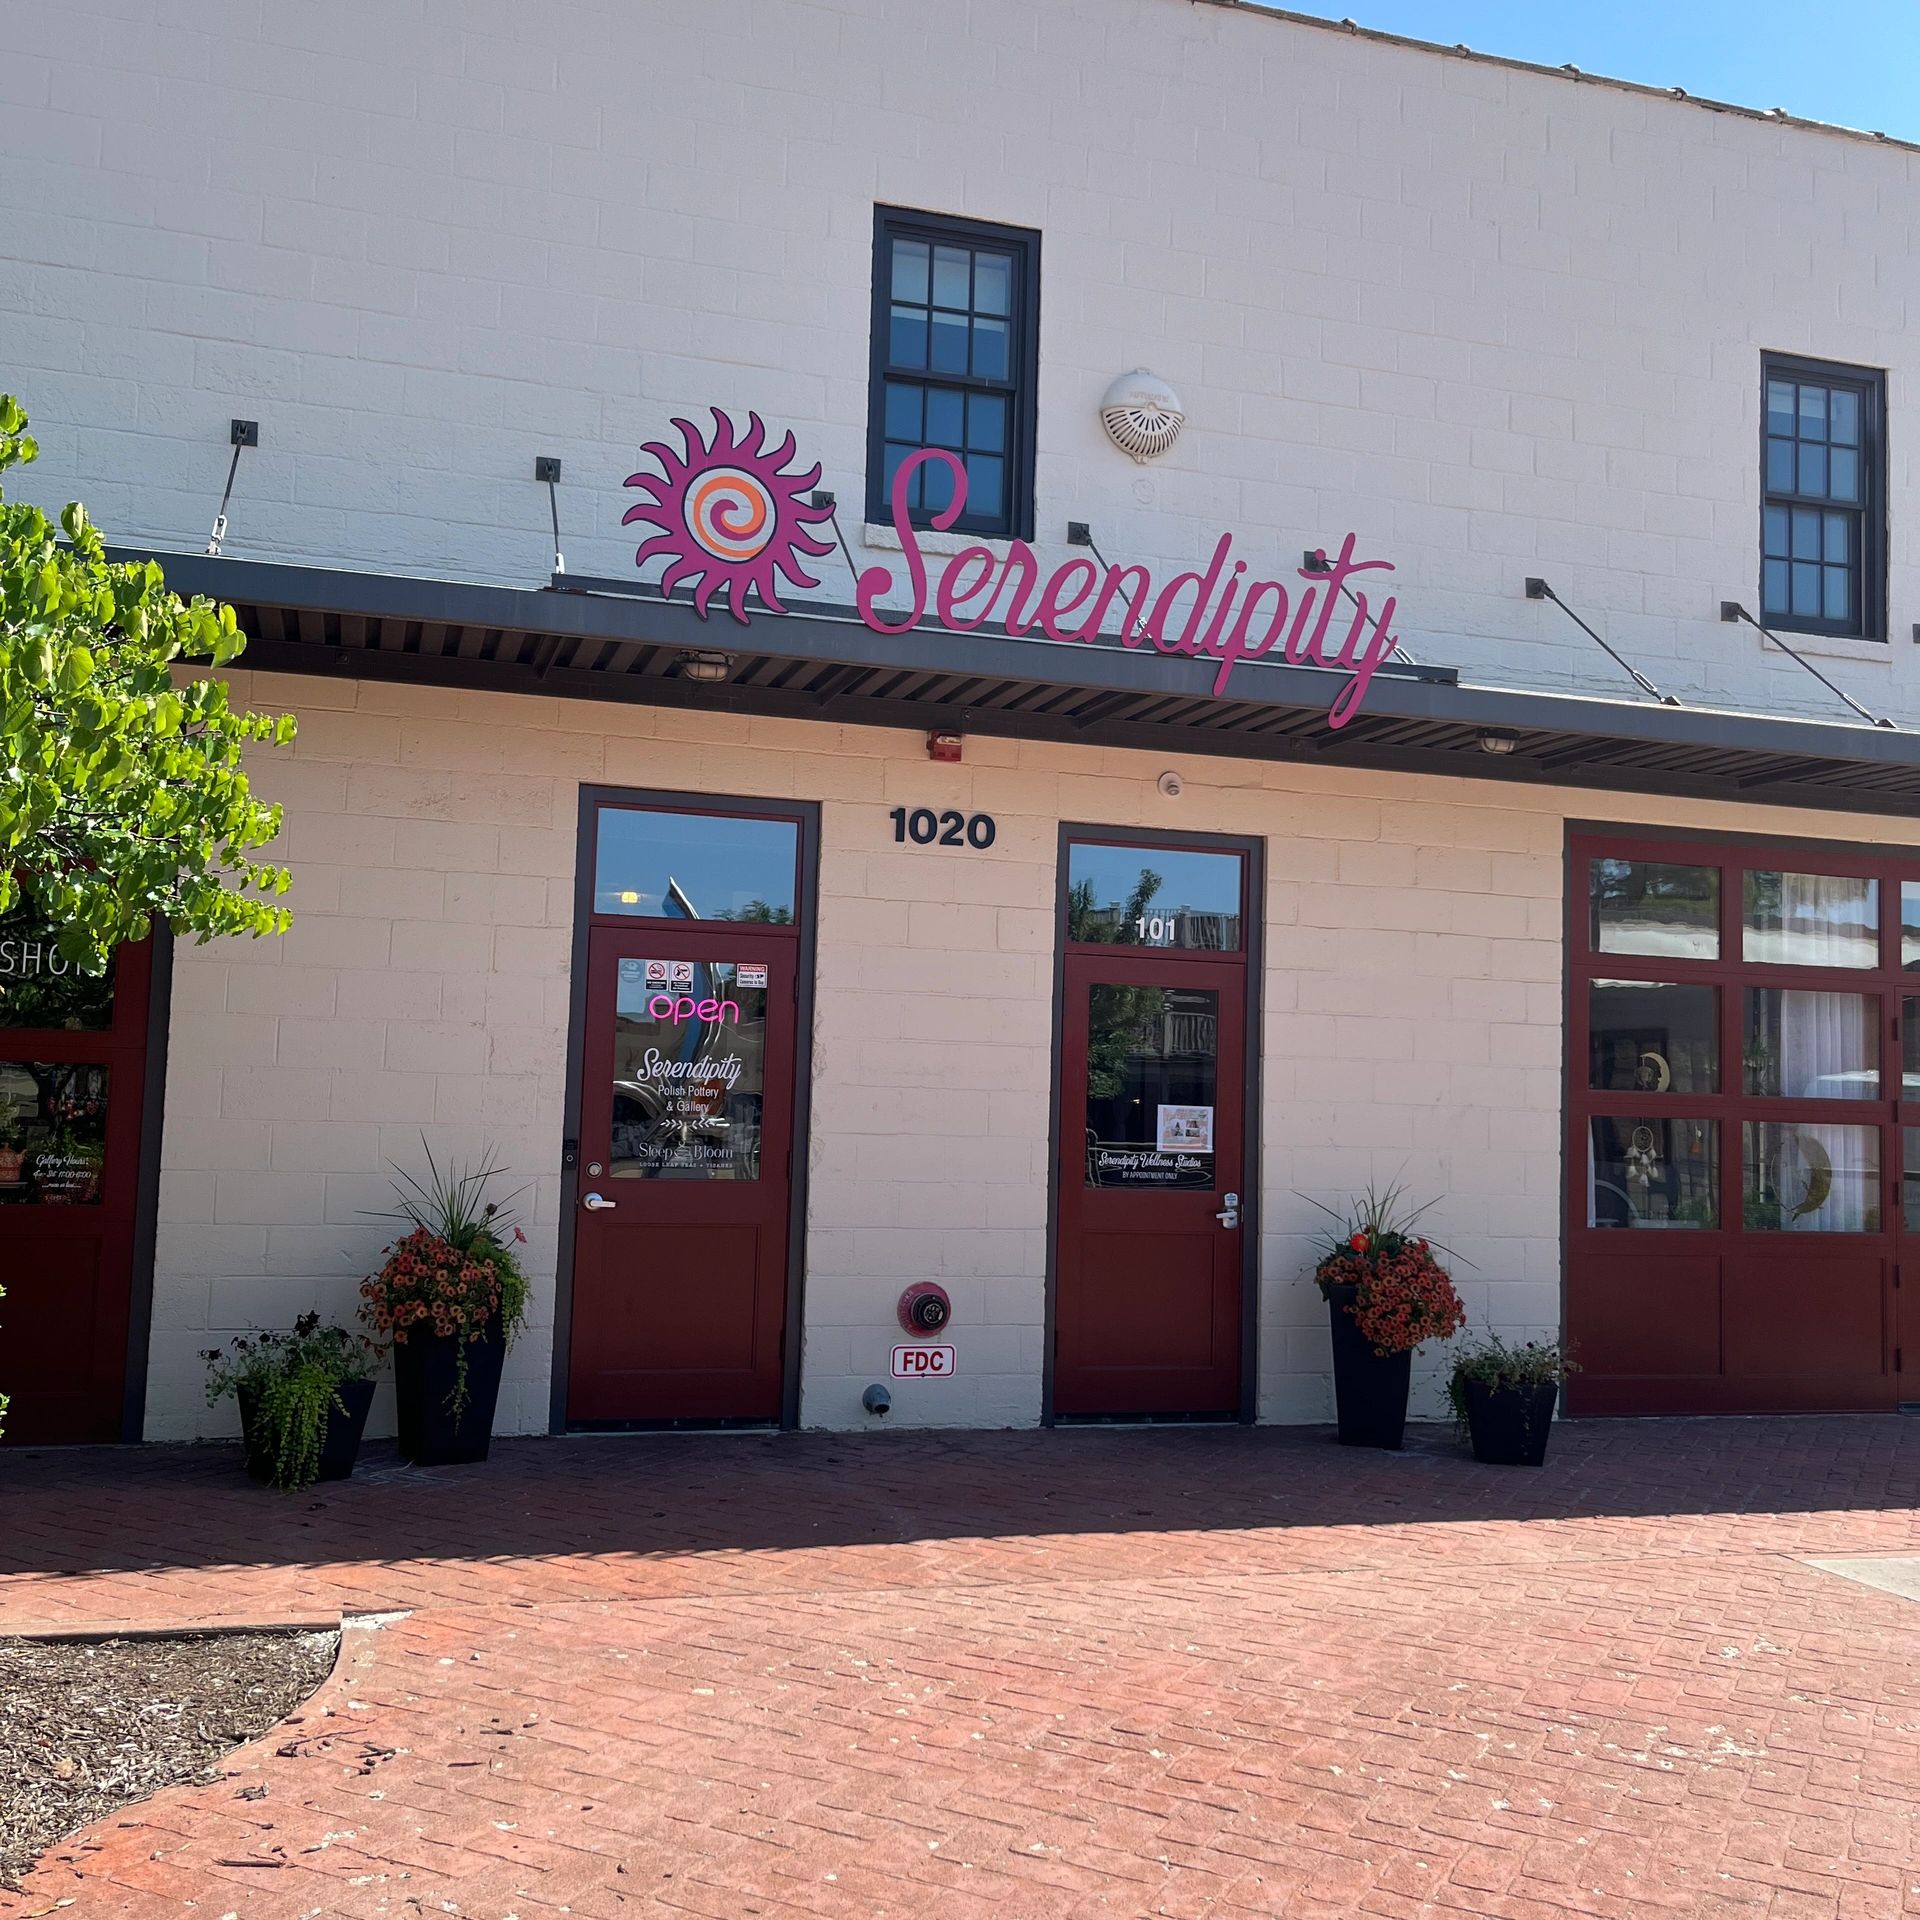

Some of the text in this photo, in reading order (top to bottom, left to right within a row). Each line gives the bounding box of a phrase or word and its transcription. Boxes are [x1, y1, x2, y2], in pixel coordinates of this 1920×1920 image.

[856, 448, 1397, 729] Serendipity
[890, 808, 996, 849] 1020
[1136, 917, 1176, 941] 101
[0, 941, 81, 975] SHO
[649, 995, 740, 1025] open
[637, 1048, 742, 1090] Serendipity
[658, 1085, 719, 1100] Polish Pottery
[666, 1101, 709, 1115] & Gallery
[36, 1154, 62, 1168] Gallery
[639, 1142, 733, 1160] Steep Bloom
[1098, 1152, 1201, 1169] Serendipity Wellness Studios
[1122, 1171, 1178, 1180] BY APPOINTMENT ONLY
[903, 1351, 943, 1371] FDC
